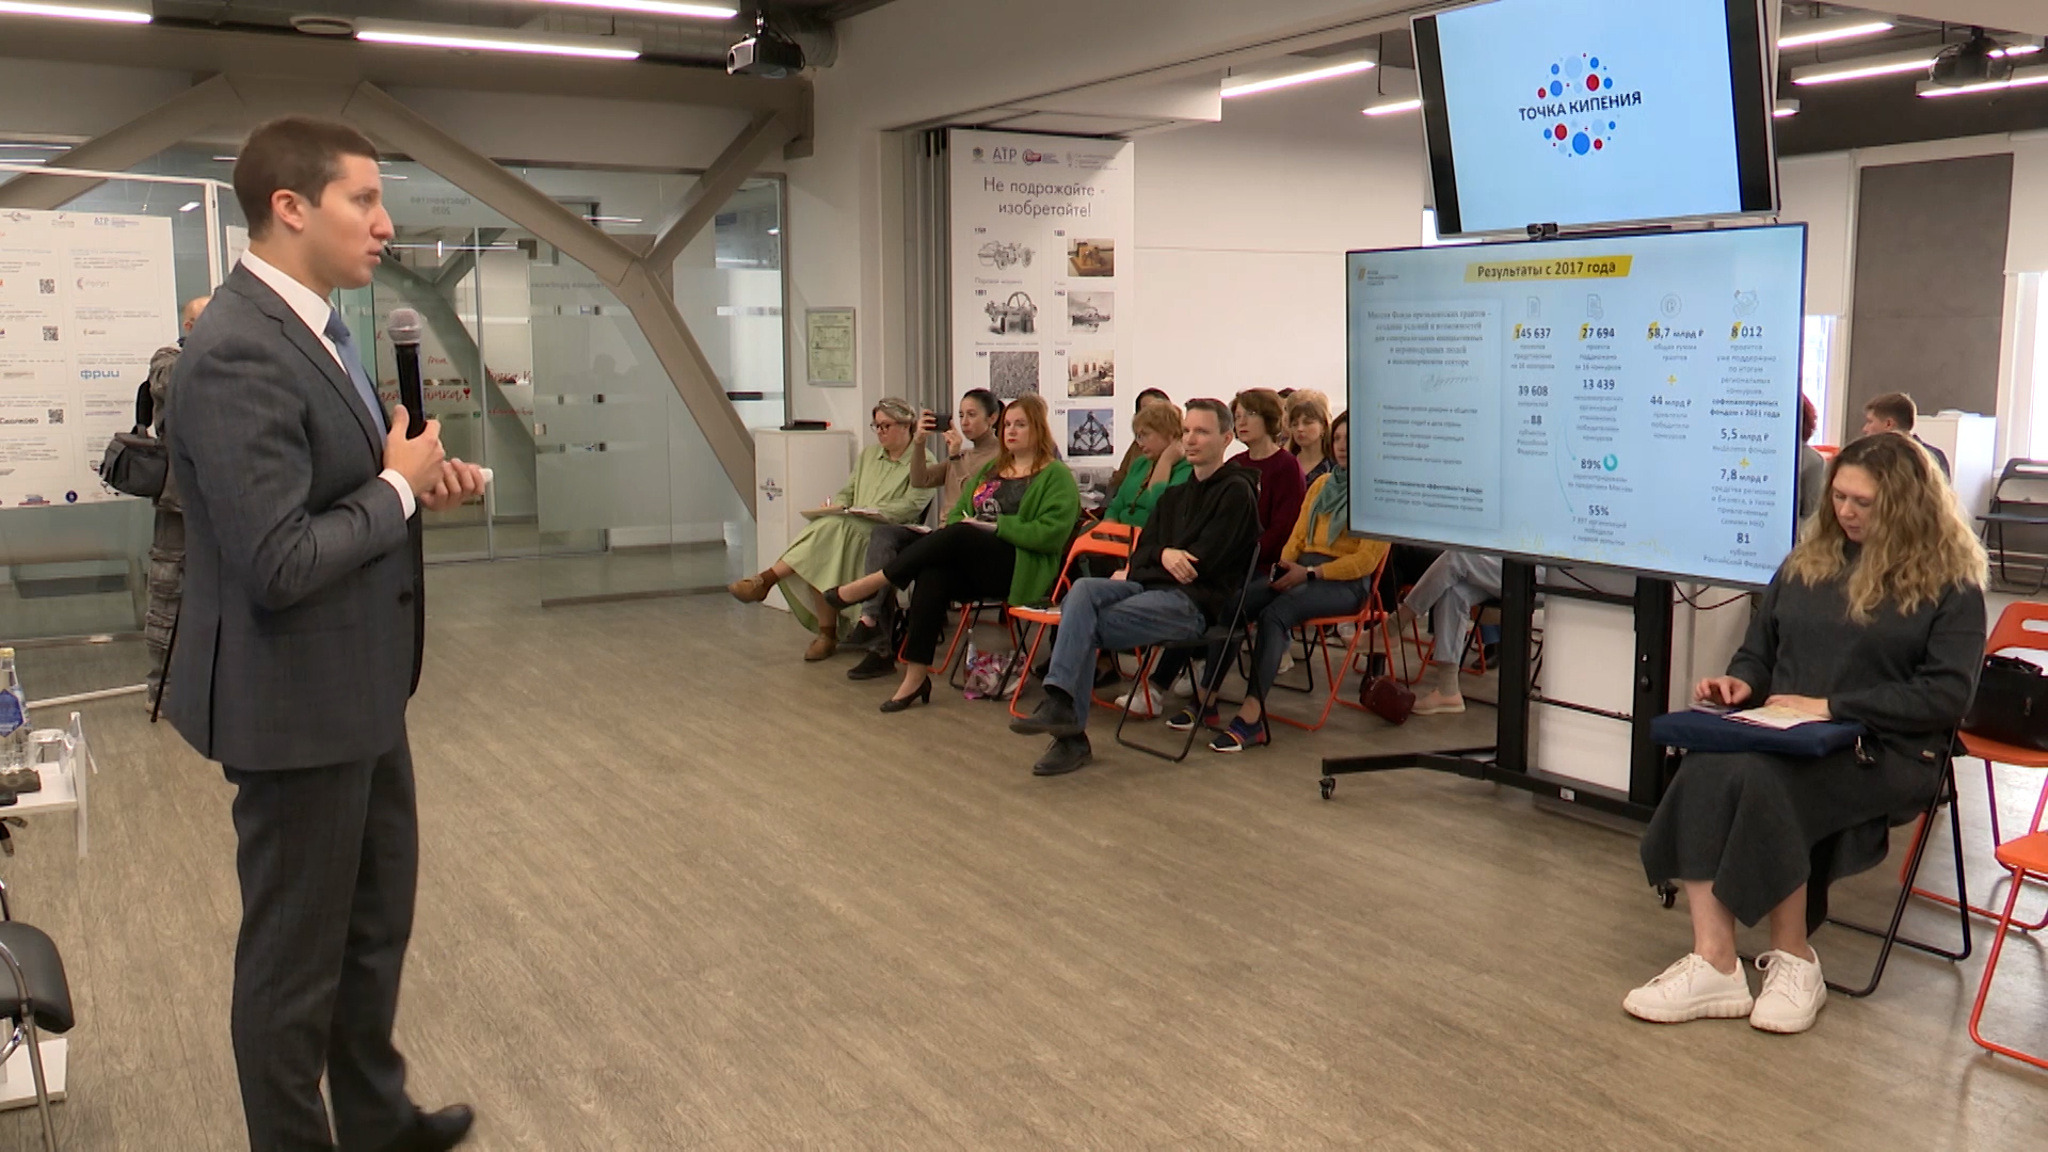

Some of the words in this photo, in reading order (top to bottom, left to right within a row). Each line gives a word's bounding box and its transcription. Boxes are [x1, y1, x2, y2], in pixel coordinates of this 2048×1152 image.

[1519, 102, 1567, 121] ТОЧКА
[1569, 91, 1642, 114] КИПЕНИЯ
[984, 177, 1004, 192] Не
[1010, 182, 1095, 197] подражайте
[998, 200, 1091, 219] изобретайте!
[1478, 265, 1542, 280] Результаты
[1546, 266, 1552, 275] с
[1555, 262, 1584, 275] 2017
[1587, 261, 1616, 276] года
[1516, 327, 1532, 339] 145
[1534, 327, 1551, 339] 637
[1582, 327, 1594, 339] 27
[1597, 327, 1615, 339] 694
[1673, 332, 1697, 340] млрд
[1731, 325, 1738, 338] 8
[1741, 325, 1763, 338] 012
[1583, 378, 1595, 390] 13
[1597, 378, 1615, 390] 439
[1531, 385, 1549, 397] 608
[1650, 395, 1663, 405] 44
[1664, 400, 1685, 408] млрд
[1531, 415, 1542, 426] 88
[1720, 427, 1738, 441] 5,5
[1739, 433, 1762, 443] млрд
[1580, 458, 1601, 470] 89%
[1720, 468, 1738, 482] 7,8
[1739, 475, 1762, 484] млрд
[1588, 504, 1609, 516] 55%
[1736, 532, 1750, 544] 81
